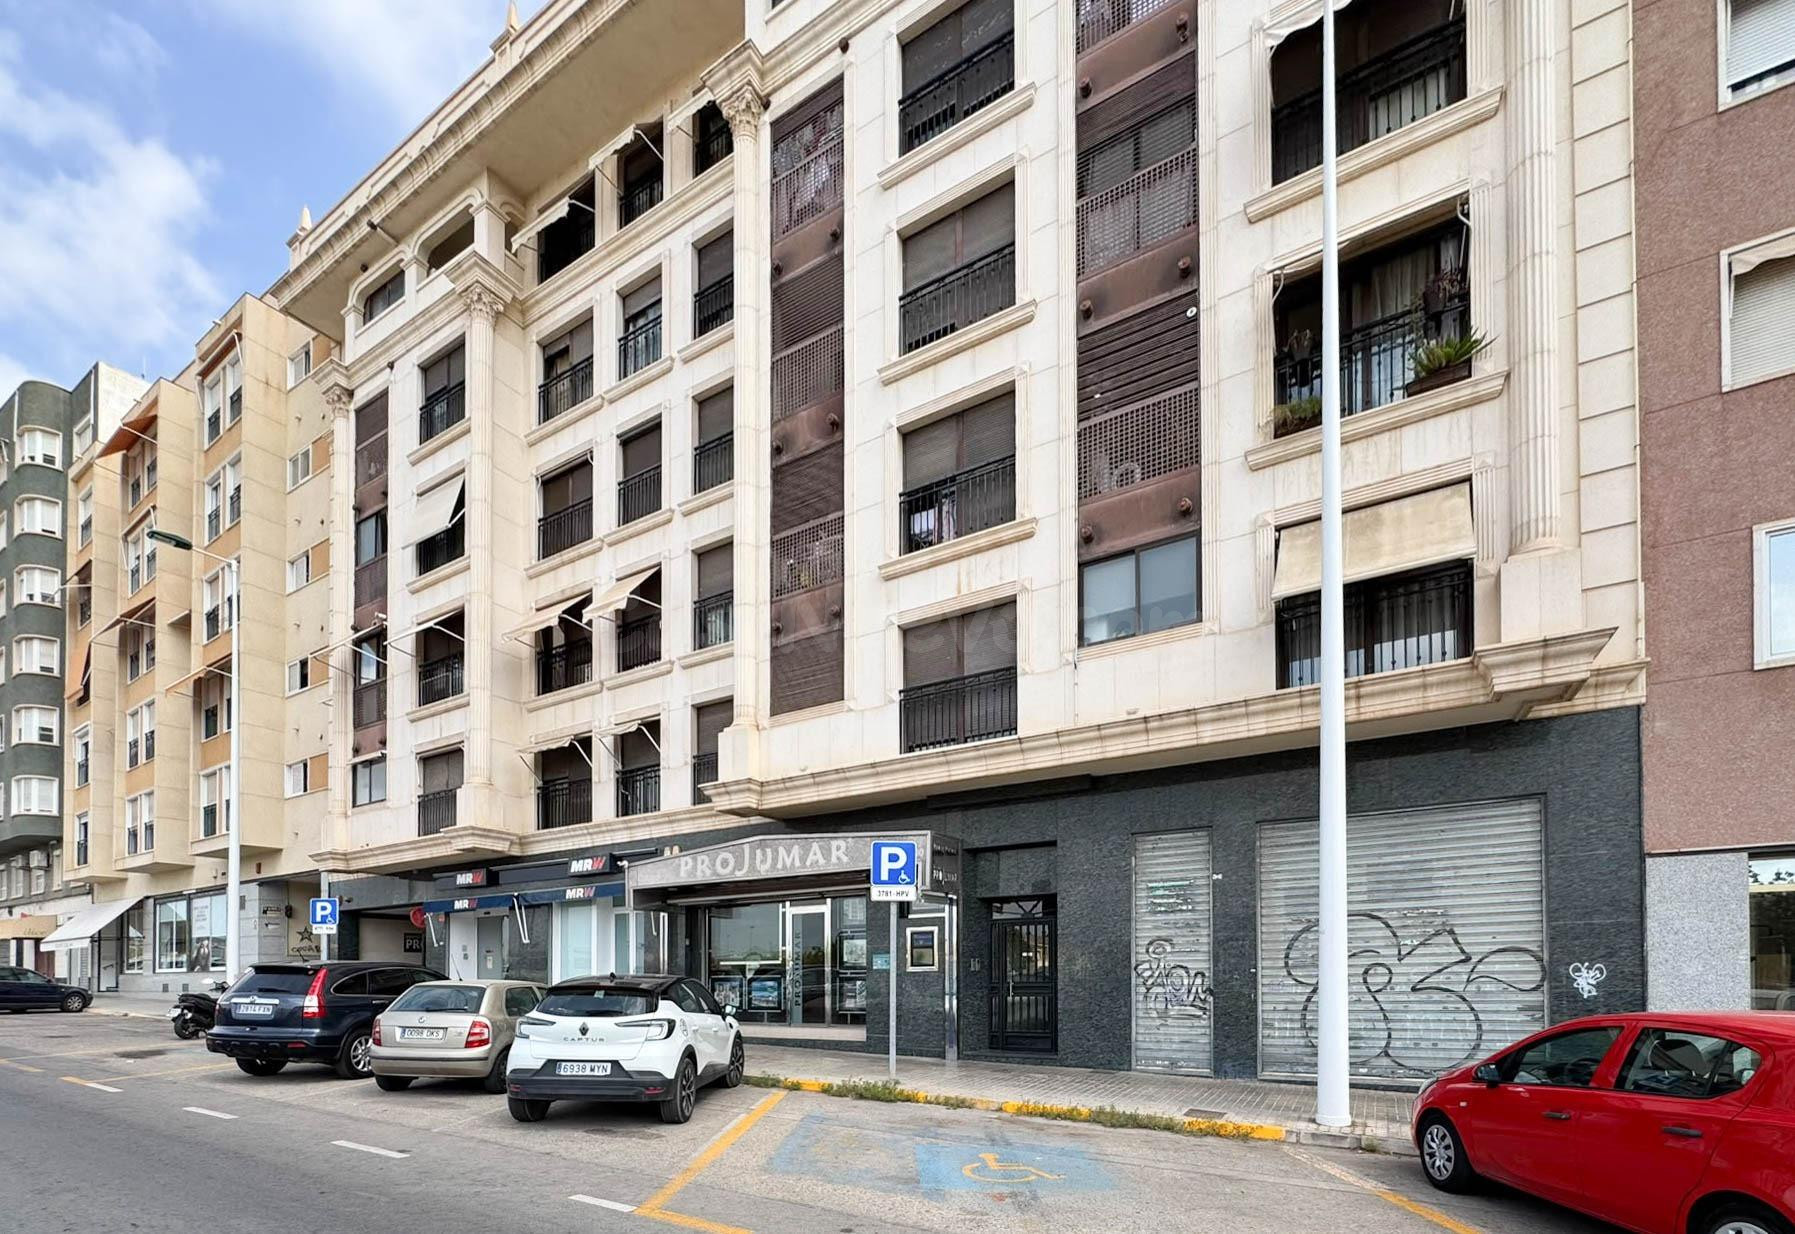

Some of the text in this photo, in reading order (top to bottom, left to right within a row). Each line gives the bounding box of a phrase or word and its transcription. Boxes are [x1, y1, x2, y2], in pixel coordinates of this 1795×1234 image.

[570, 856, 606, 873] MRW
[680, 840, 849, 877] PROJUMAR
[881, 847, 907, 881] P
[456, 871, 483, 885] MRW
[565, 886, 596, 900] MRW
[453, 898, 478, 910] MRW
[316, 902, 332, 922] P
[563, 1064, 608, 1073] 6938 MYN
